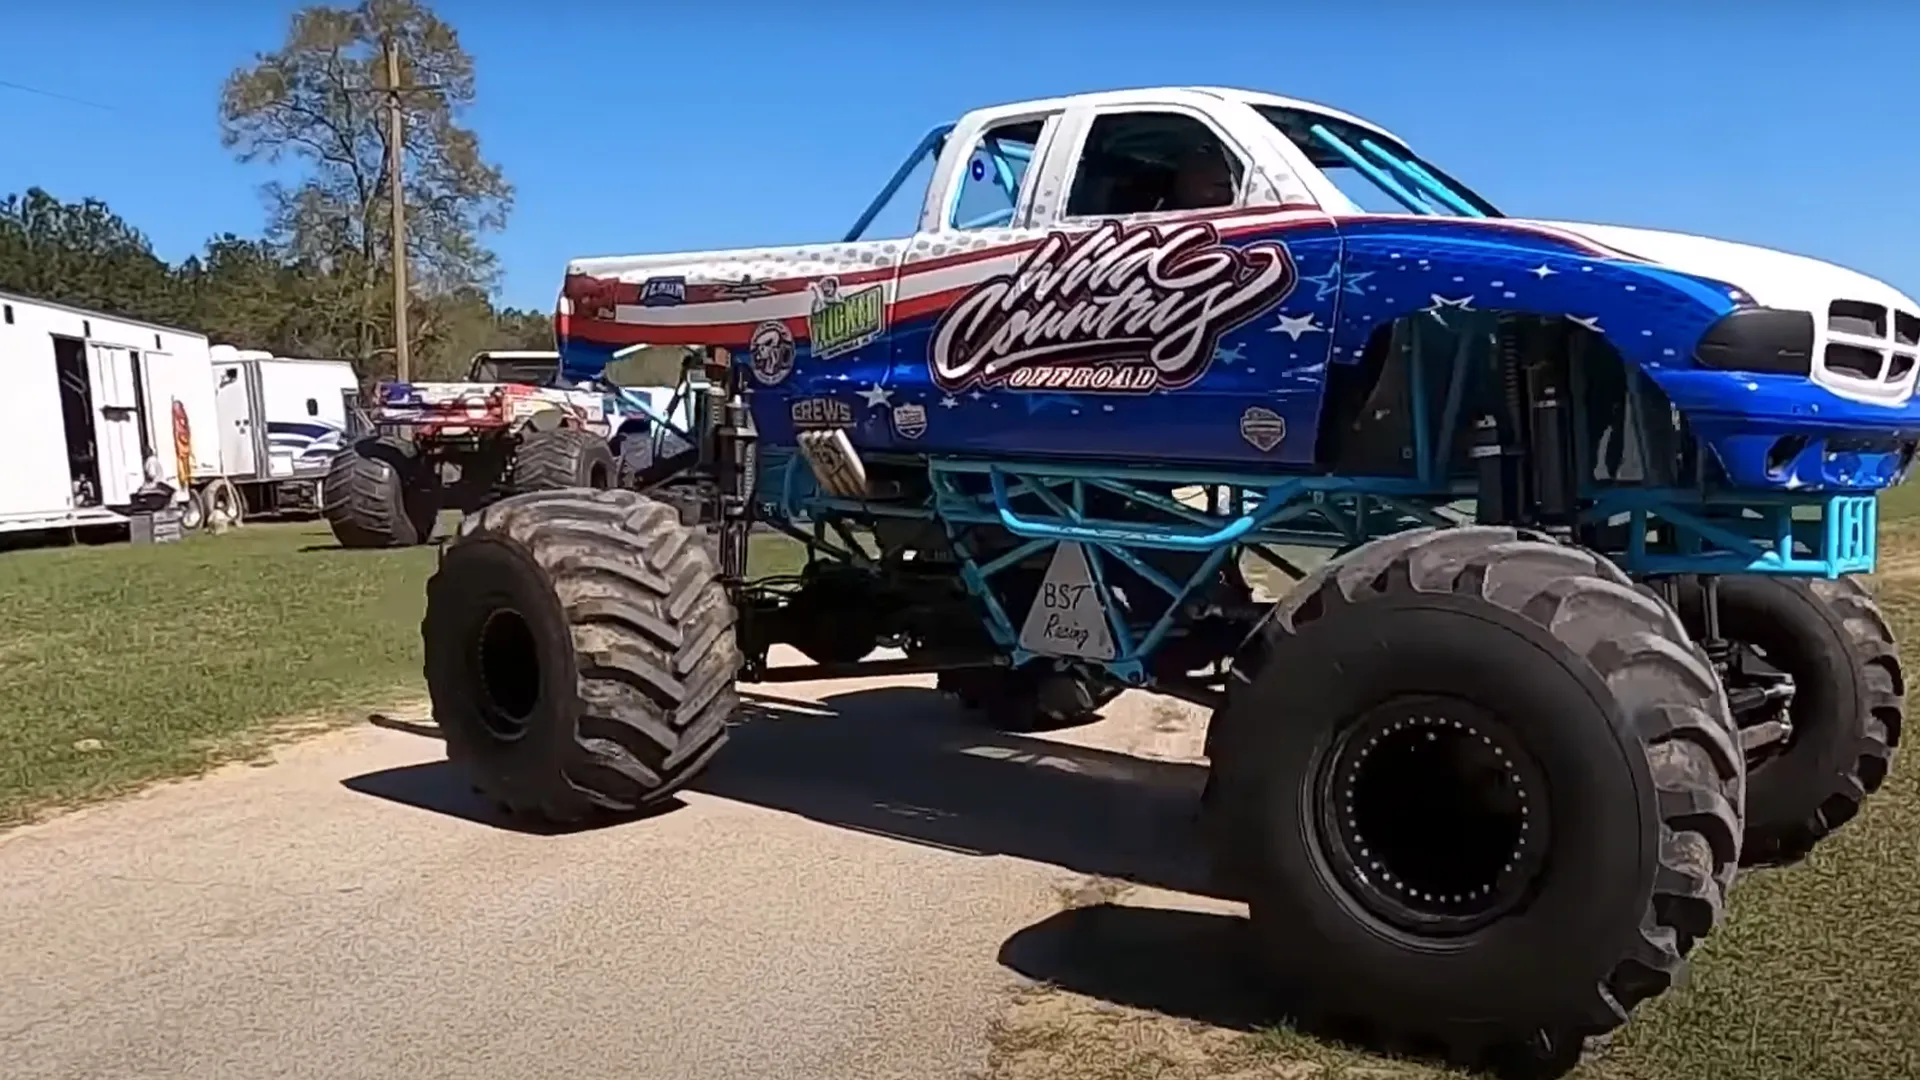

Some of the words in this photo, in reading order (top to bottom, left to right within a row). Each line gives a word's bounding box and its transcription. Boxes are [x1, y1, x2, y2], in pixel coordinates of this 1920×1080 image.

[934, 246, 1282, 380] Country
[1009, 366, 1158, 388] OFFROAD
[1043, 582, 1092, 610] BST
[1043, 613, 1089, 650] Racing
